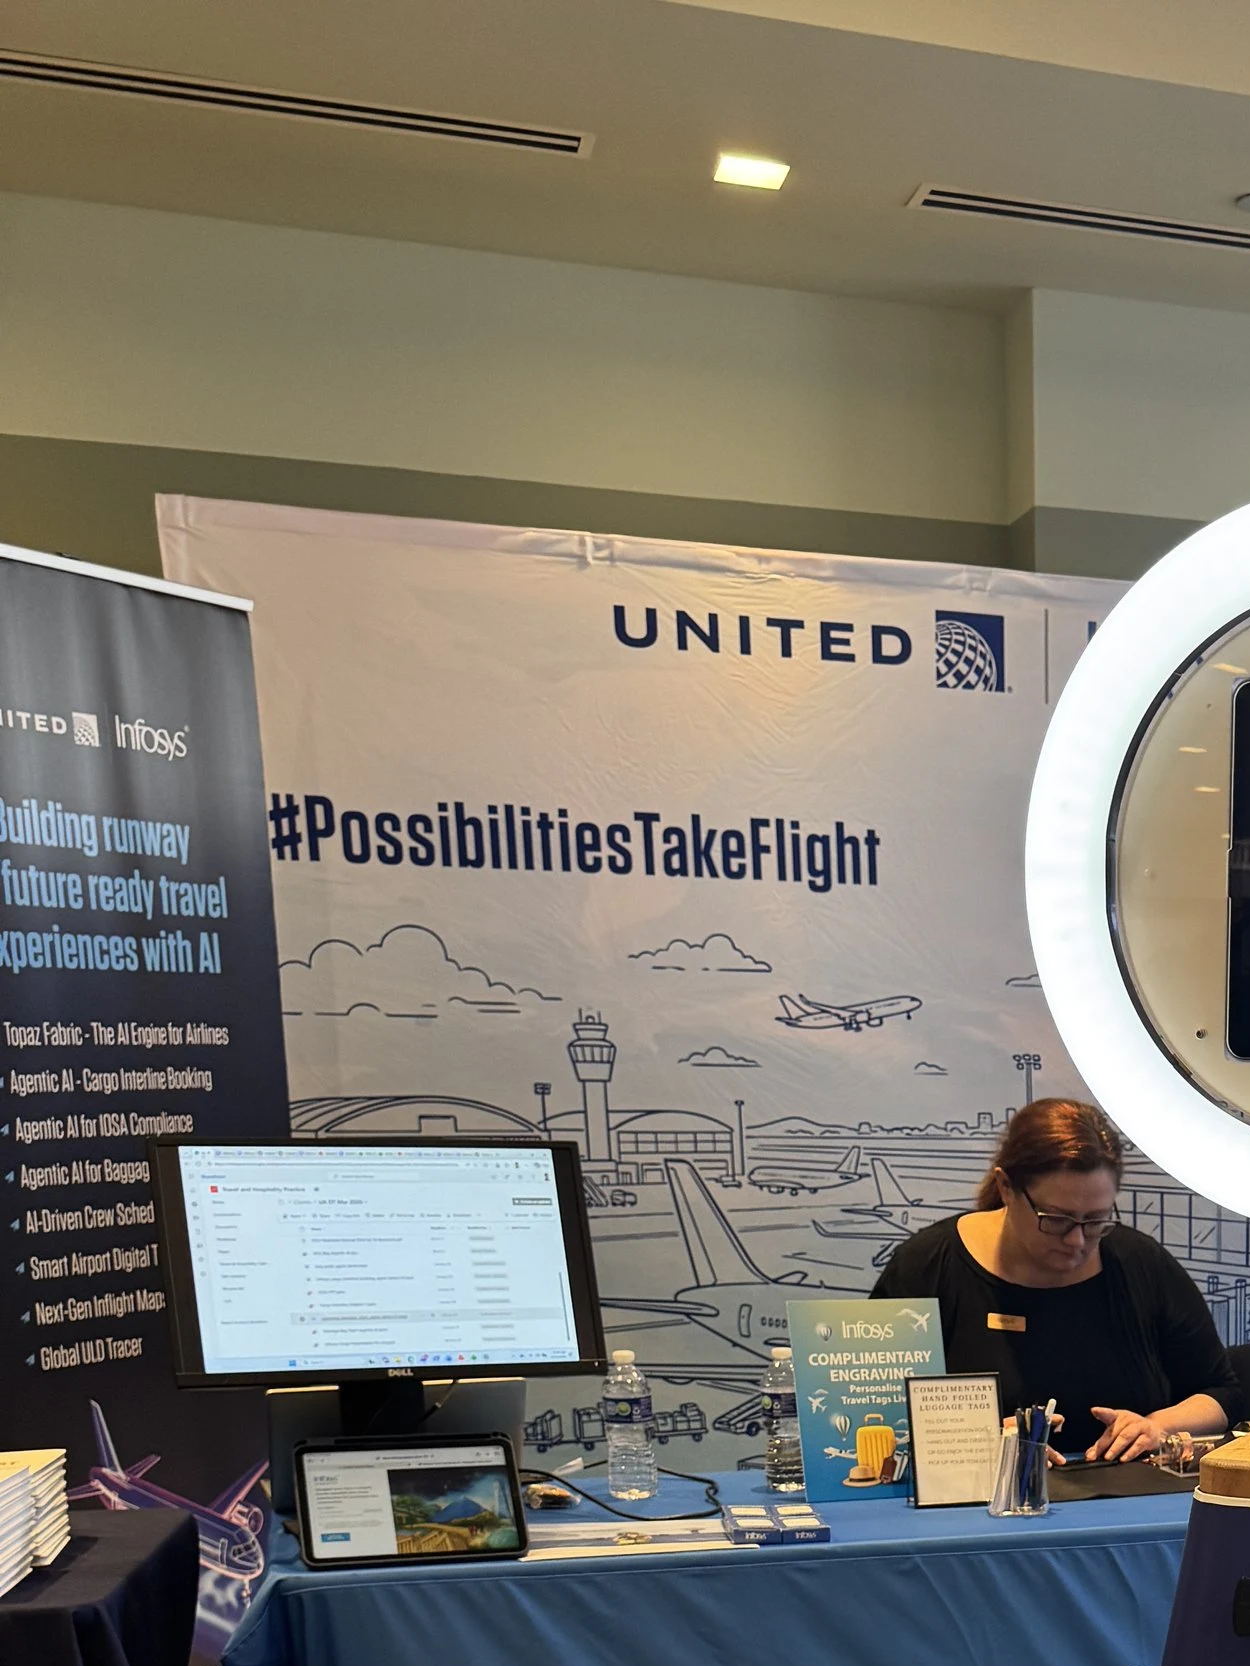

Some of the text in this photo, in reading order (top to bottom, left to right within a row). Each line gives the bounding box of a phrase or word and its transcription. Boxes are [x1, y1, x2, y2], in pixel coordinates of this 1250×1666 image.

[613, 604, 913, 665] UNITED
[0, 708, 67, 735] ITED
[102, 816, 190, 865] runway
[269, 792, 881, 894] #PossibilitiesTakeFlight
[1, 859, 228, 920] future ready travel
[141, 930, 193, 973] with
[199, 932, 222, 974] AI
[3, 1021, 42, 1049] Topaz
[43, 1021, 83, 1046] Fabric
[90, 1021, 116, 1046] The
[117, 1021, 130, 1046] AI
[130, 1021, 167, 1049] Engine
[167, 1021, 183, 1046] for
[186, 1021, 229, 1046] Airlines
[10, 1068, 60, 1098] Agentic
[61, 1067, 75, 1093] AI
[82, 1067, 119, 1095] Cargo
[120, 1066, 167, 1091] Interline
[166, 1065, 213, 1092] Booking
[15, 1111, 194, 1145] Agentic AI for IOSA Compliance
[21, 1162, 70, 1191] Agentic
[71, 1160, 85, 1185] AI
[85, 1159, 101, 1183] for
[26, 1208, 83, 1235] AI-Driven
[84, 1204, 115, 1230] Crew
[30, 1254, 69, 1281] Smart
[71, 1251, 111, 1278] Airport
[112, 1247, 150, 1274] Digital
[35, 1295, 93, 1327] Next-Gen
[94, 1292, 135, 1319] Inflight
[842, 1320, 894, 1342] Infosys
[40, 1335, 143, 1372] Global ULD Tracer
[808, 1350, 932, 1367] COMPLIMENTARY
[387, 1368, 414, 1378] DELL
[830, 1367, 914, 1383] ENGRAVING
[849, 1383, 902, 1394] Personalise
[841, 1395, 869, 1406] Travel
[871, 1395, 892, 1406] Tags
[913, 1384, 994, 1394] COMPLIMENTARY
[922, 1393, 987, 1402] HAND FOILED
[920, 1402, 991, 1412] LUGGAGE TAGS
